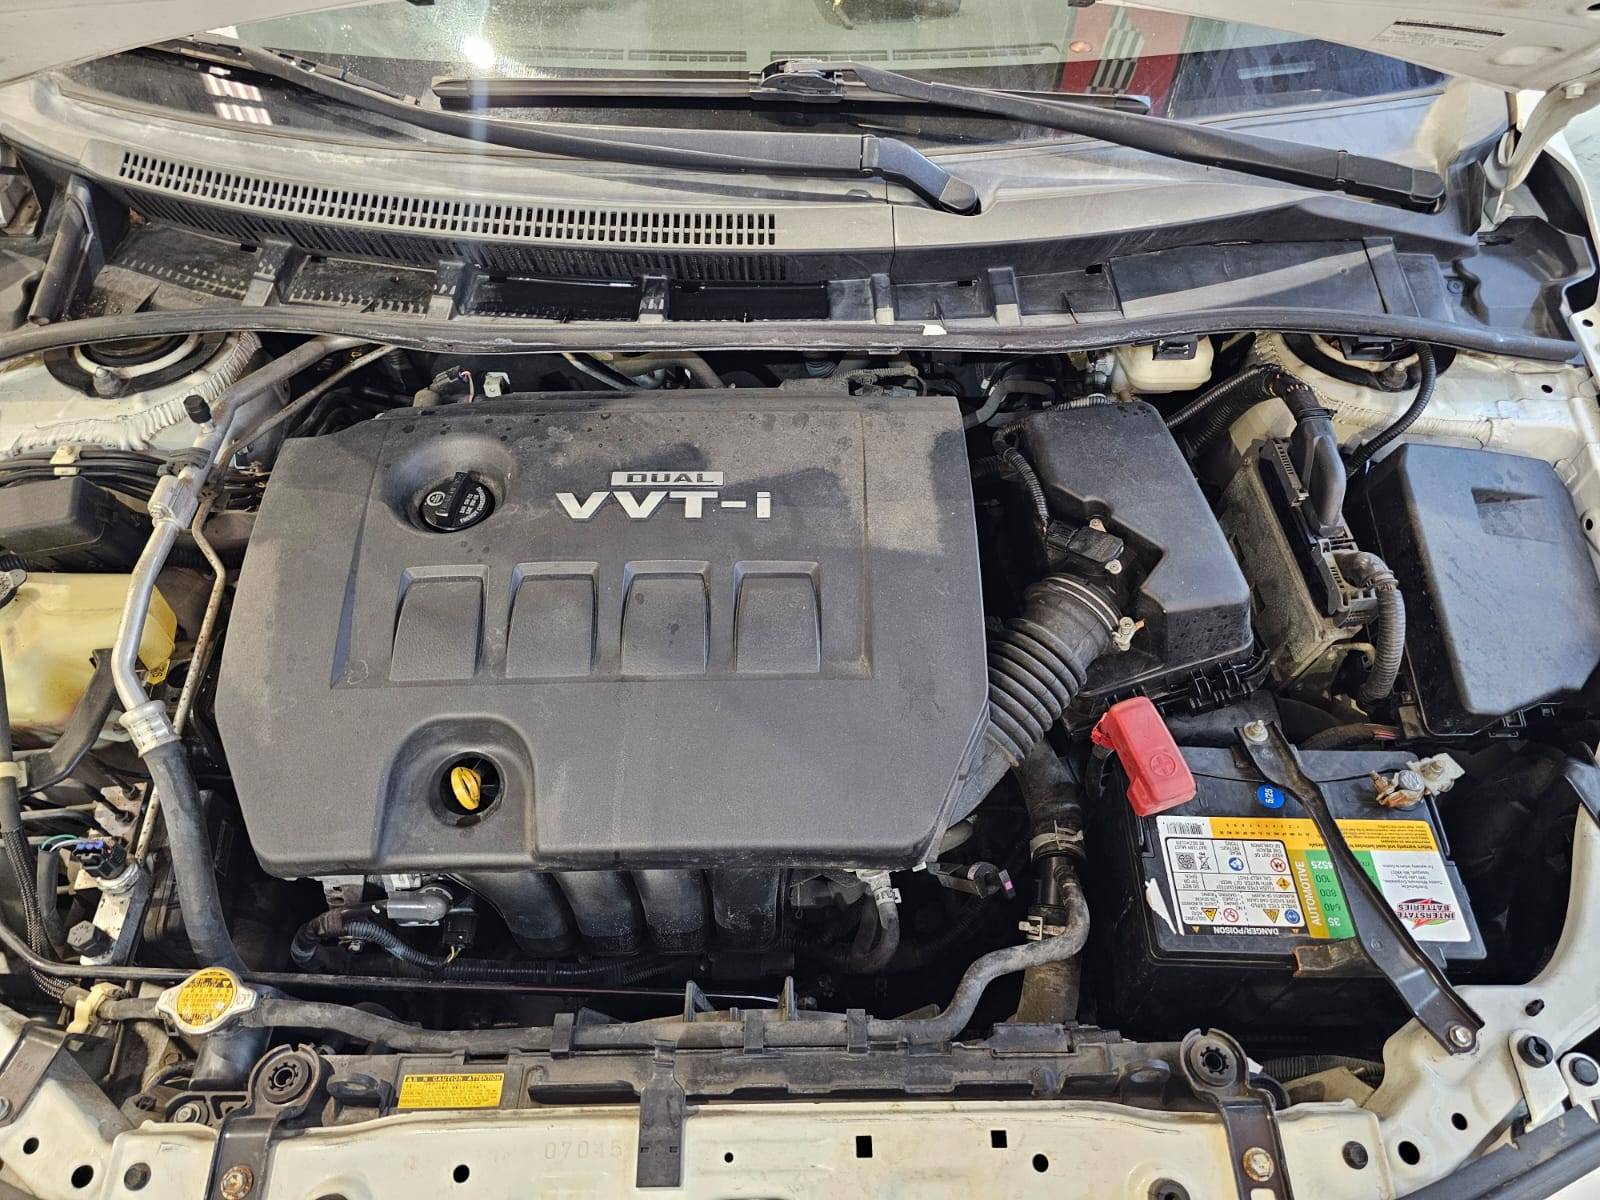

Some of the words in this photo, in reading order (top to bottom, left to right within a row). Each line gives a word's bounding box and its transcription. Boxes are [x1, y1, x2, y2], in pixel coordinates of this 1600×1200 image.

[625, 472, 717, 484] DUAL
[555, 491, 772, 519] VVT-i
[1294, 860, 1322, 926] AUTOMOTIVE
[1320, 889, 1336, 897] 800
[1328, 916, 1341, 927] 35
[1213, 927, 1279, 935] DANGER/POISON
